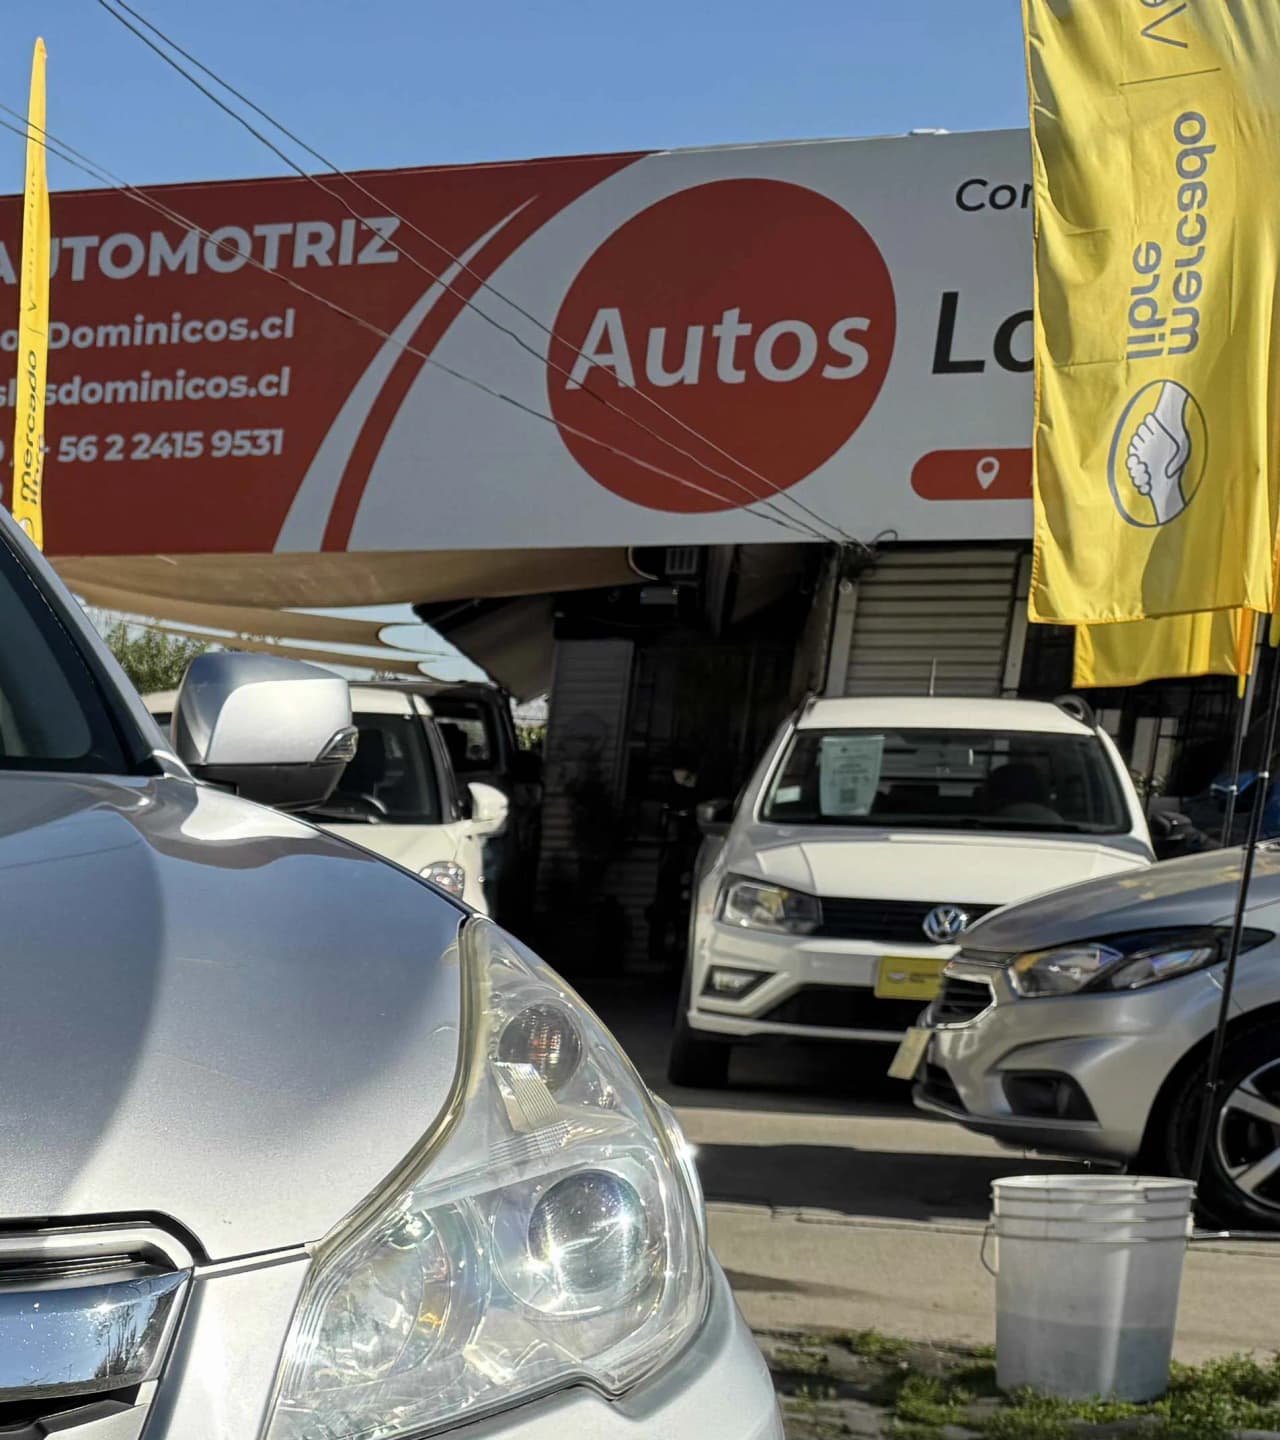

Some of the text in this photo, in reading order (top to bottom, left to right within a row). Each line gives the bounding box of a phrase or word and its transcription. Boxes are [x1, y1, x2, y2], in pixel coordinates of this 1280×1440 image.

[565, 306, 871, 390] Autos
[57, 434, 99, 463] 56
[103, 433, 125, 461] 2
[130, 430, 204, 461] 2415
[210, 427, 285, 459] 9531
